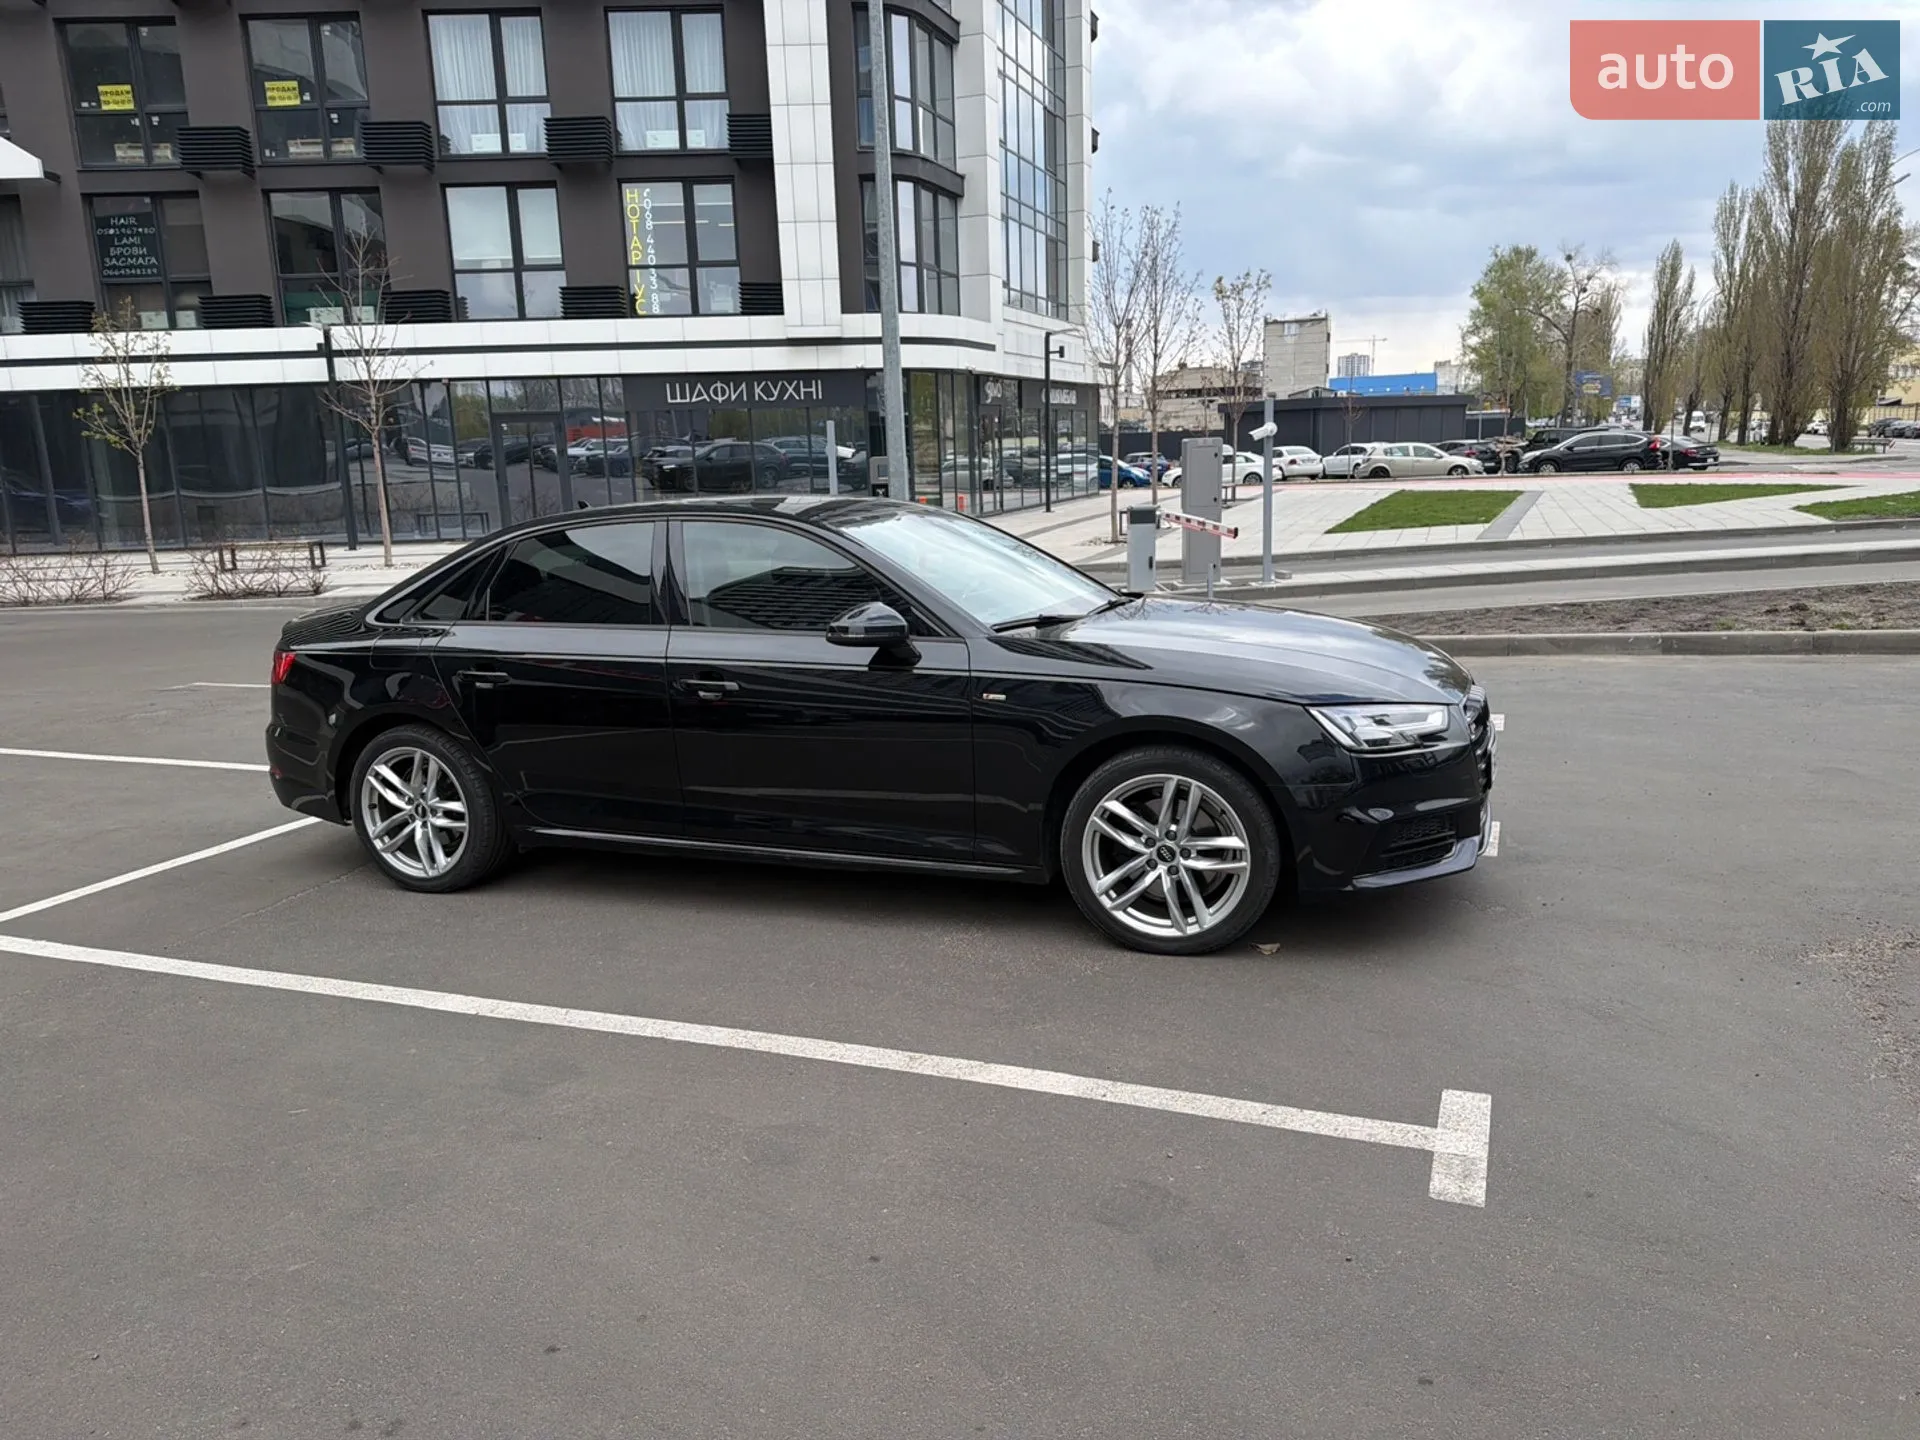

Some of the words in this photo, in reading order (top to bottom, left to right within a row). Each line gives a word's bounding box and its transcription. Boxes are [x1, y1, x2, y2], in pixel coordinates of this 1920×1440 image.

[110, 216, 138, 226] HAIR
[643, 199, 653, 231] 068
[109, 246, 147, 256] БРОВИ
[114, 236, 141, 246] LAMI
[646, 234, 656, 265] 440
[103, 256, 158, 267] ЗАСМАГА
[625, 188, 647, 316] НОТАРІУС
[651, 294, 660, 314] 88
[665, 380, 748, 404] ШАФИ
[753, 379, 824, 402] КУХНІ
